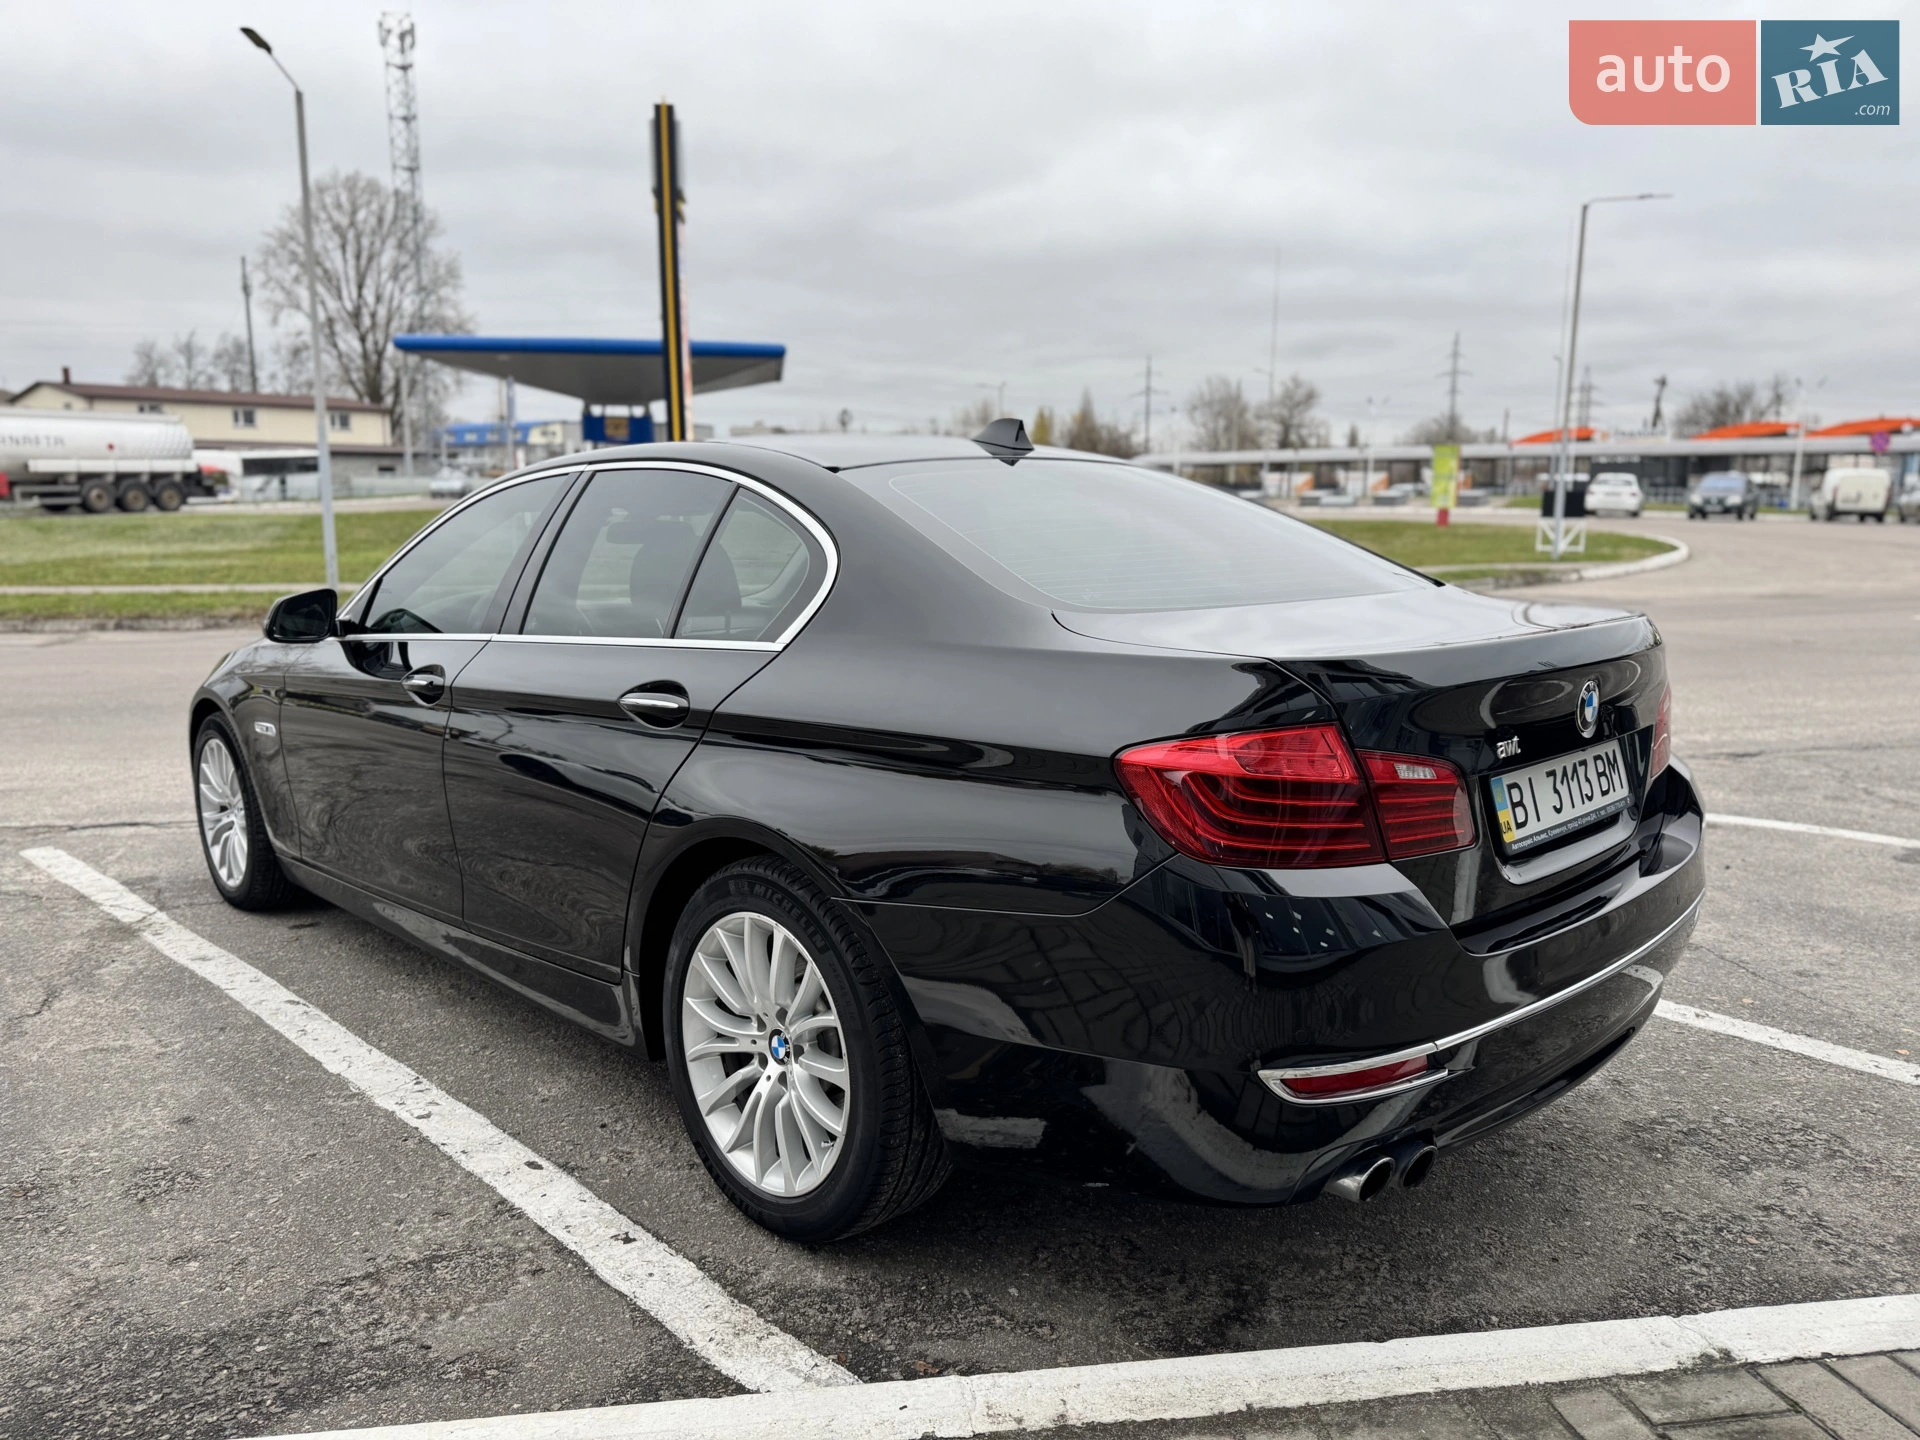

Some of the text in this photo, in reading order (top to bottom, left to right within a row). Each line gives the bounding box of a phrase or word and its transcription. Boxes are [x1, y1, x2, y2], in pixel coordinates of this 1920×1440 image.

[1506, 776, 1541, 830] BI
[1545, 758, 1594, 814] 3113
[1593, 748, 1624, 797] BM
[753, 883, 826, 948] MICHELIN
